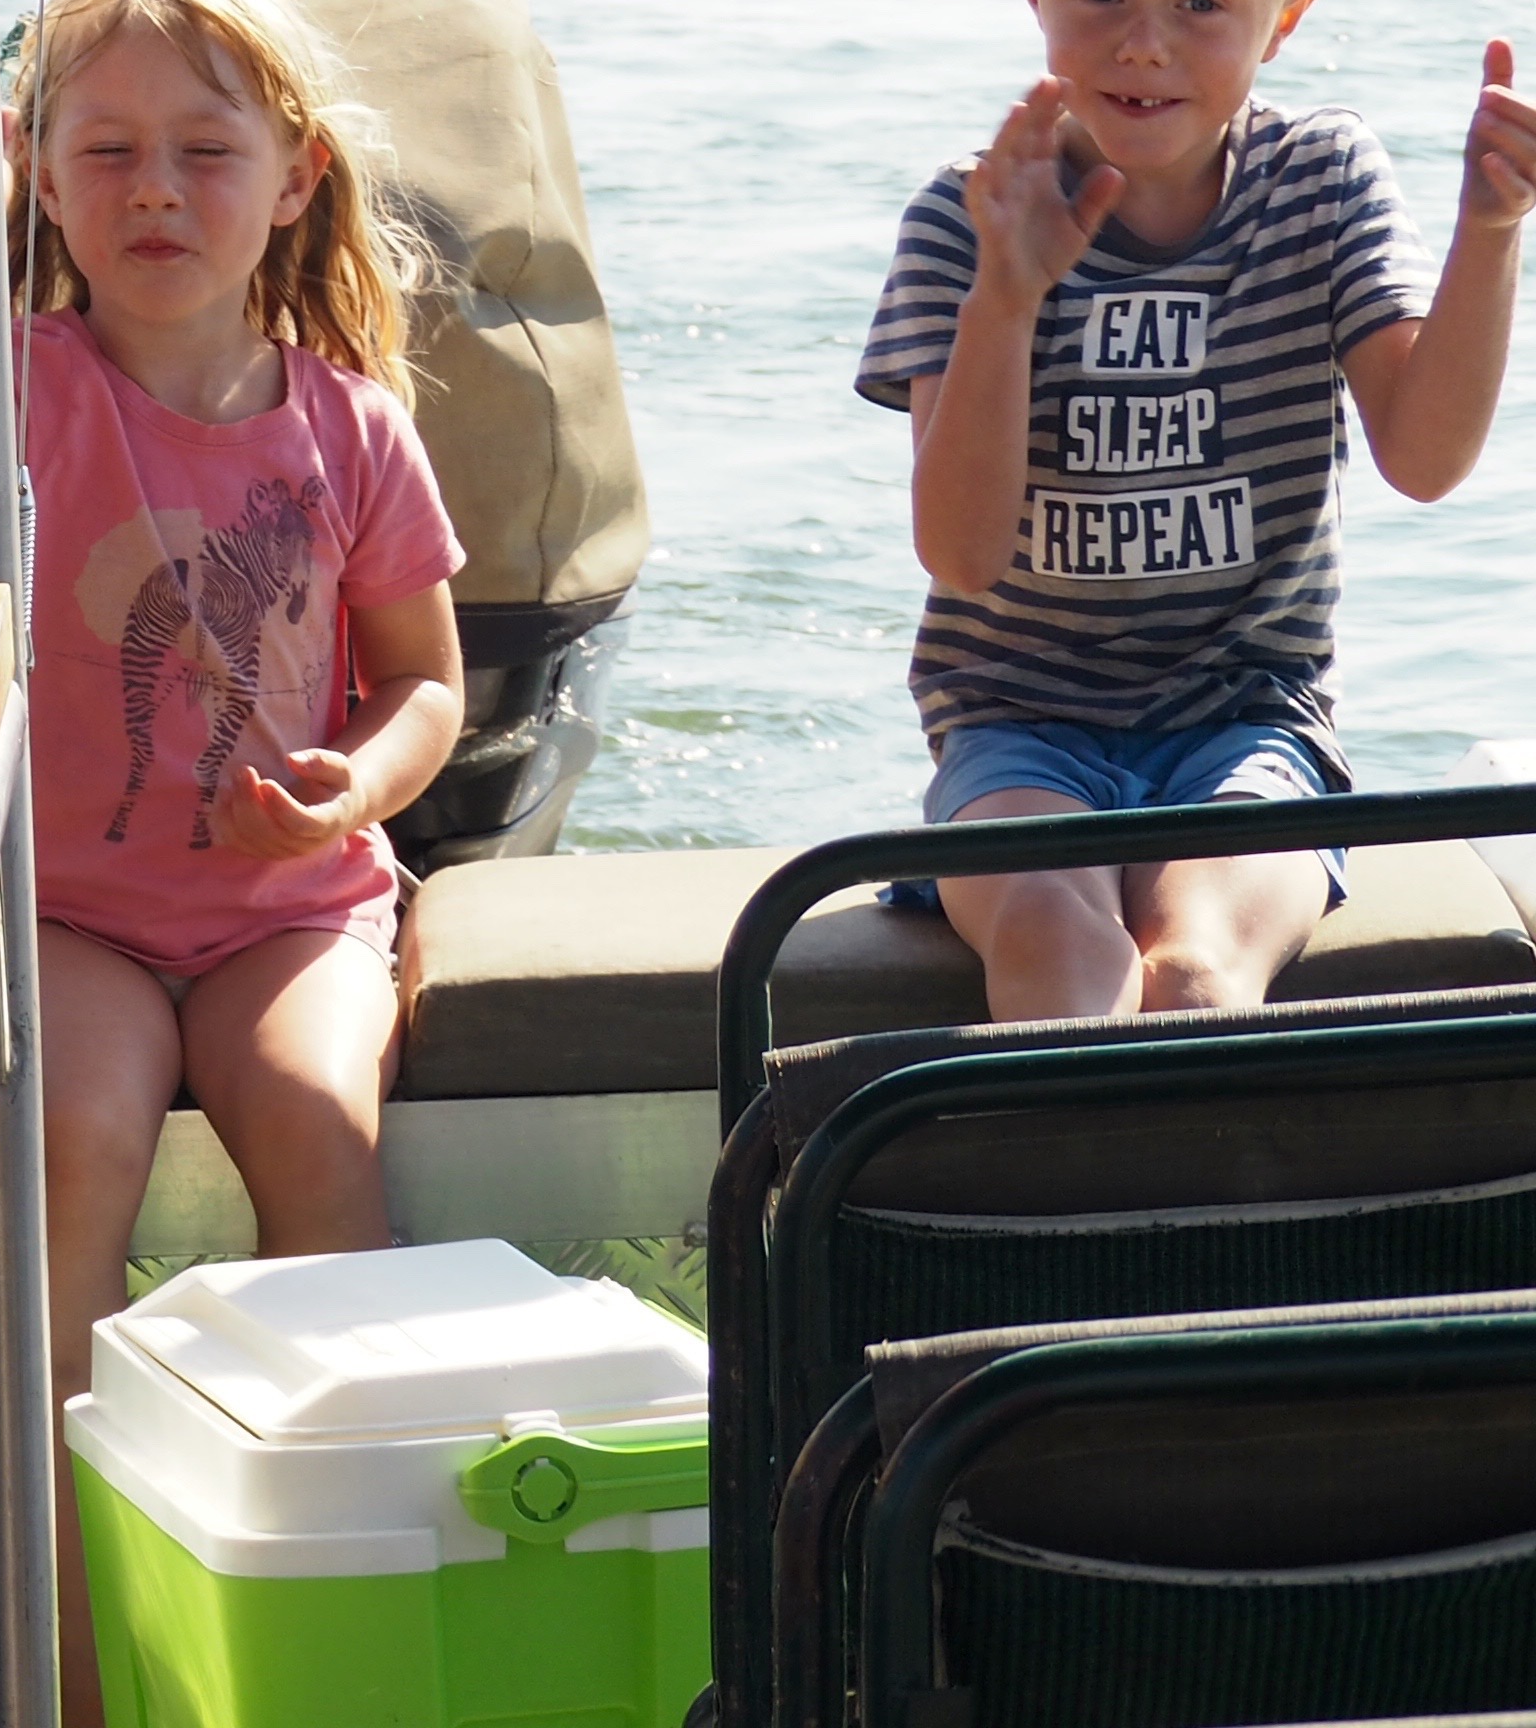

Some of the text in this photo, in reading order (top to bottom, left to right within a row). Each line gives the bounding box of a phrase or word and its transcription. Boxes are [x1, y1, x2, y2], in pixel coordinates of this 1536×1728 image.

[1095, 299, 1201, 368] EAT
[1066, 388, 1215, 472] SLEEP
[1043, 487, 1244, 574] REPEAT
